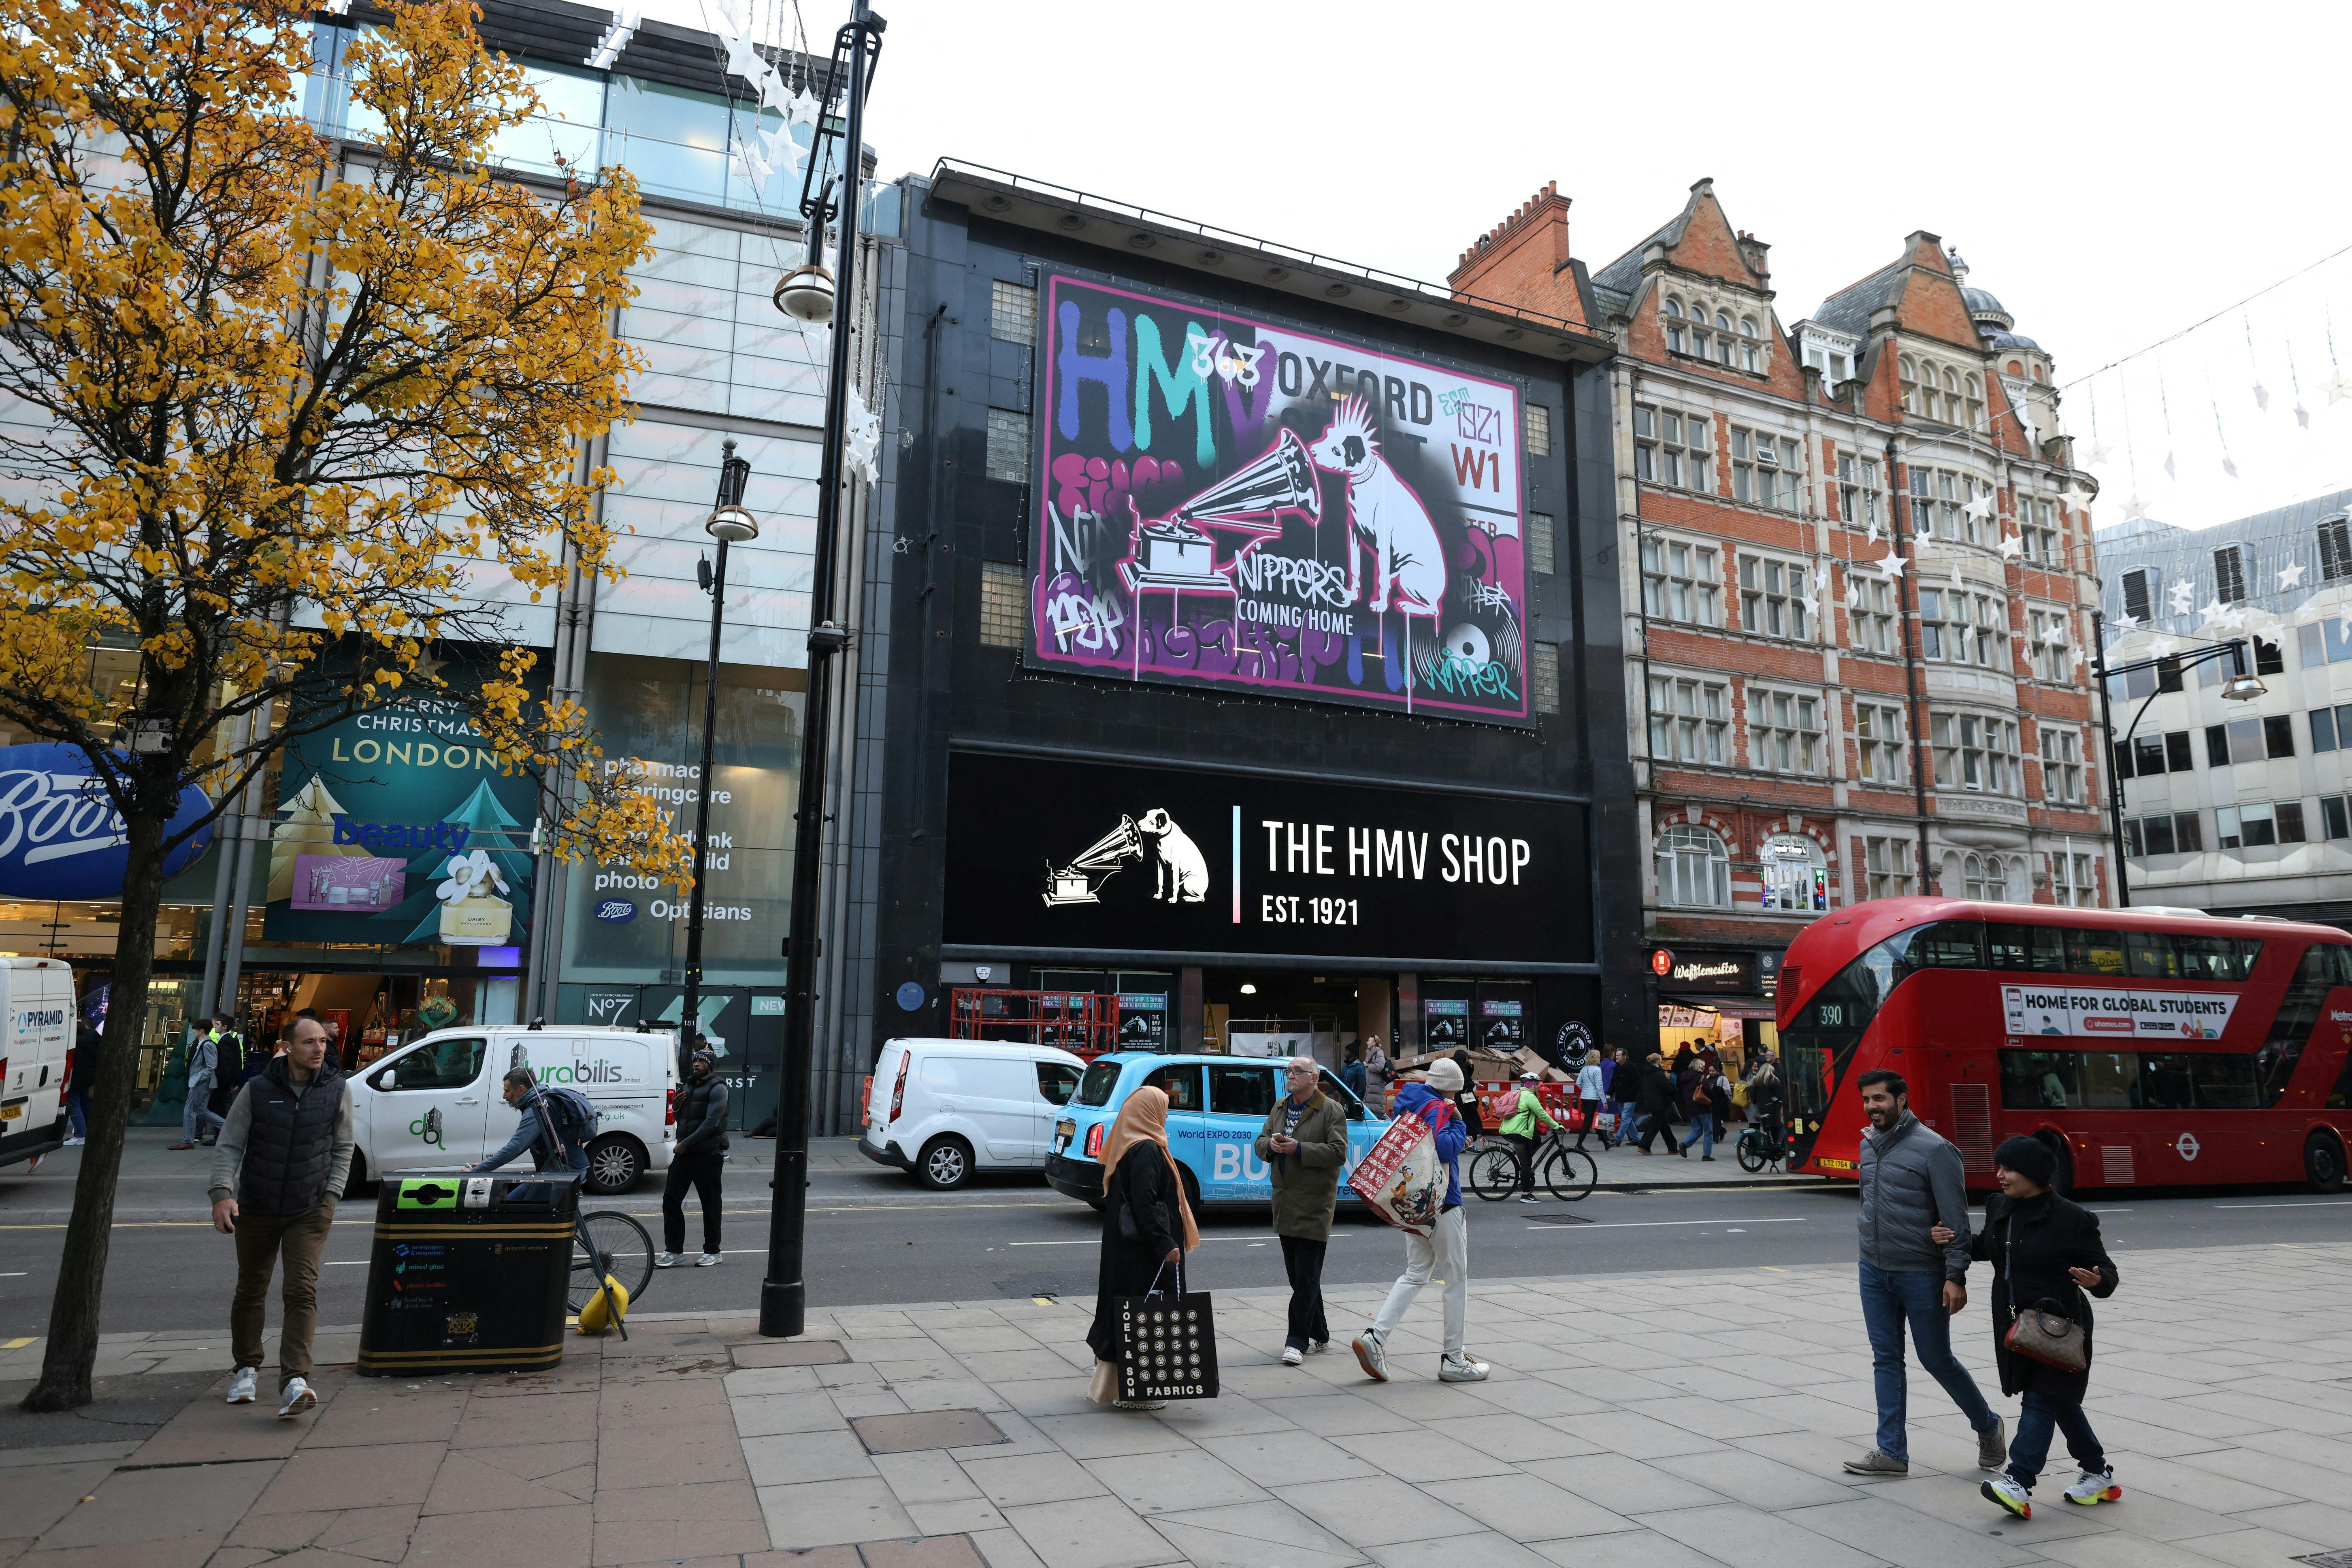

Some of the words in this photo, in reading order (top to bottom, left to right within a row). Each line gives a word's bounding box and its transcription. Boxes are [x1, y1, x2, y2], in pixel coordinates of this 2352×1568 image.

[1187, 332, 1265, 392] 363
[1058, 301, 1279, 469] HMV
[1278, 351, 1432, 426] OXFORD
[1438, 387, 1470, 417] EST
[1456, 399, 1501, 446] 1921
[1451, 443, 1500, 493] W1
[1237, 598, 1302, 629] COMING
[1308, 609, 1354, 636] HOME
[386, 697, 461, 716] MERRY
[357, 715, 482, 737] CHRISTMAS
[332, 737, 498, 771] LONDON
[604, 756, 701, 779] pharmac
[0, 769, 130, 866] Boo
[333, 814, 471, 856] beauty
[680, 830, 732, 849] dnk
[1262, 820, 1335, 875] THE
[1349, 827, 1429, 880] HMV
[1441, 833, 1530, 886] SHOP
[595, 871, 659, 891] photo
[1815, 869, 1824, 903] WATCH
[597, 901, 632, 919] Boots
[650, 899, 752, 921] Optcians
[1262, 895, 1305, 924] EST.
[1309, 897, 1358, 925] 1921
[1674, 961, 1739, 981] Wafflemeister
[1821, 1006, 1842, 1025] 390
[2026, 995, 2067, 1009] HOME
[2071, 996, 2098, 1011] FOR
[2103, 997, 2157, 1012] GLOBAL
[2159, 999, 2227, 1015] STUDENTS
[27, 1025, 63, 1033] INTERNATIONAL
[28, 1010, 63, 1027] PYRAMID
[1565, 1024, 1579, 1032] HMV
[1580, 1026, 1591, 1044] SHOP
[693, 1054, 711, 1064] TERYX
[1178, 1129, 1205, 1139] World
[1207, 1131, 1230, 1139] EXPO
[1231, 1131, 1252, 1140] 2030
[1214, 1144, 1360, 1181] BUN
[1835, 1160, 1848, 1168] 1764
[1123, 1300, 1131, 1342] JOEL
[1125, 1350, 1133, 1359] &
[1126, 1367, 1135, 1397] SON
[1146, 1385, 1204, 1397] FABRICS
